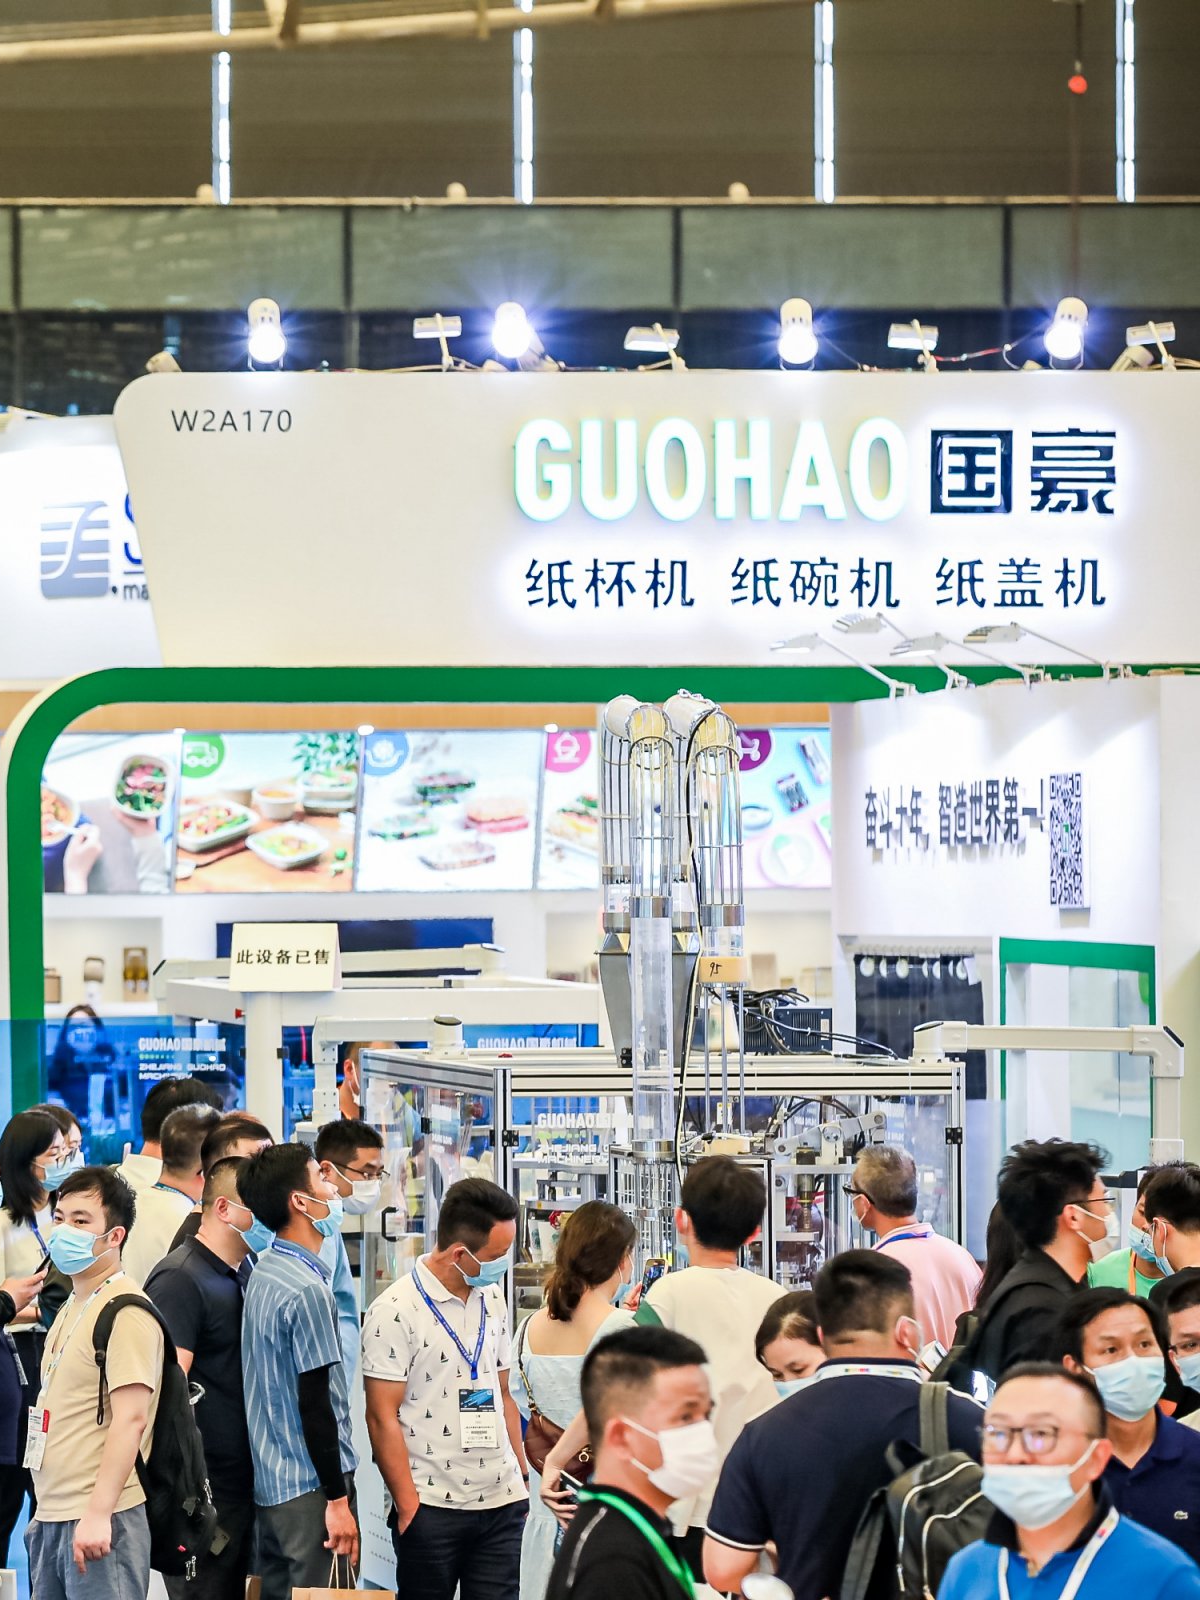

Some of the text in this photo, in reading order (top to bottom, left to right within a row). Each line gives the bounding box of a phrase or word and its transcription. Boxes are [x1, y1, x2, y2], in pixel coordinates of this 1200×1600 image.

[172, 409, 293, 433] W2A170
[514, 418, 1117, 522] GUOHAO 国豪
[524, 557, 1107, 609] 纸杯机 纸碗机 纸盖机
[237, 949, 330, 965] 此设备已售
[138, 1037, 180, 1051] GUOHAO
